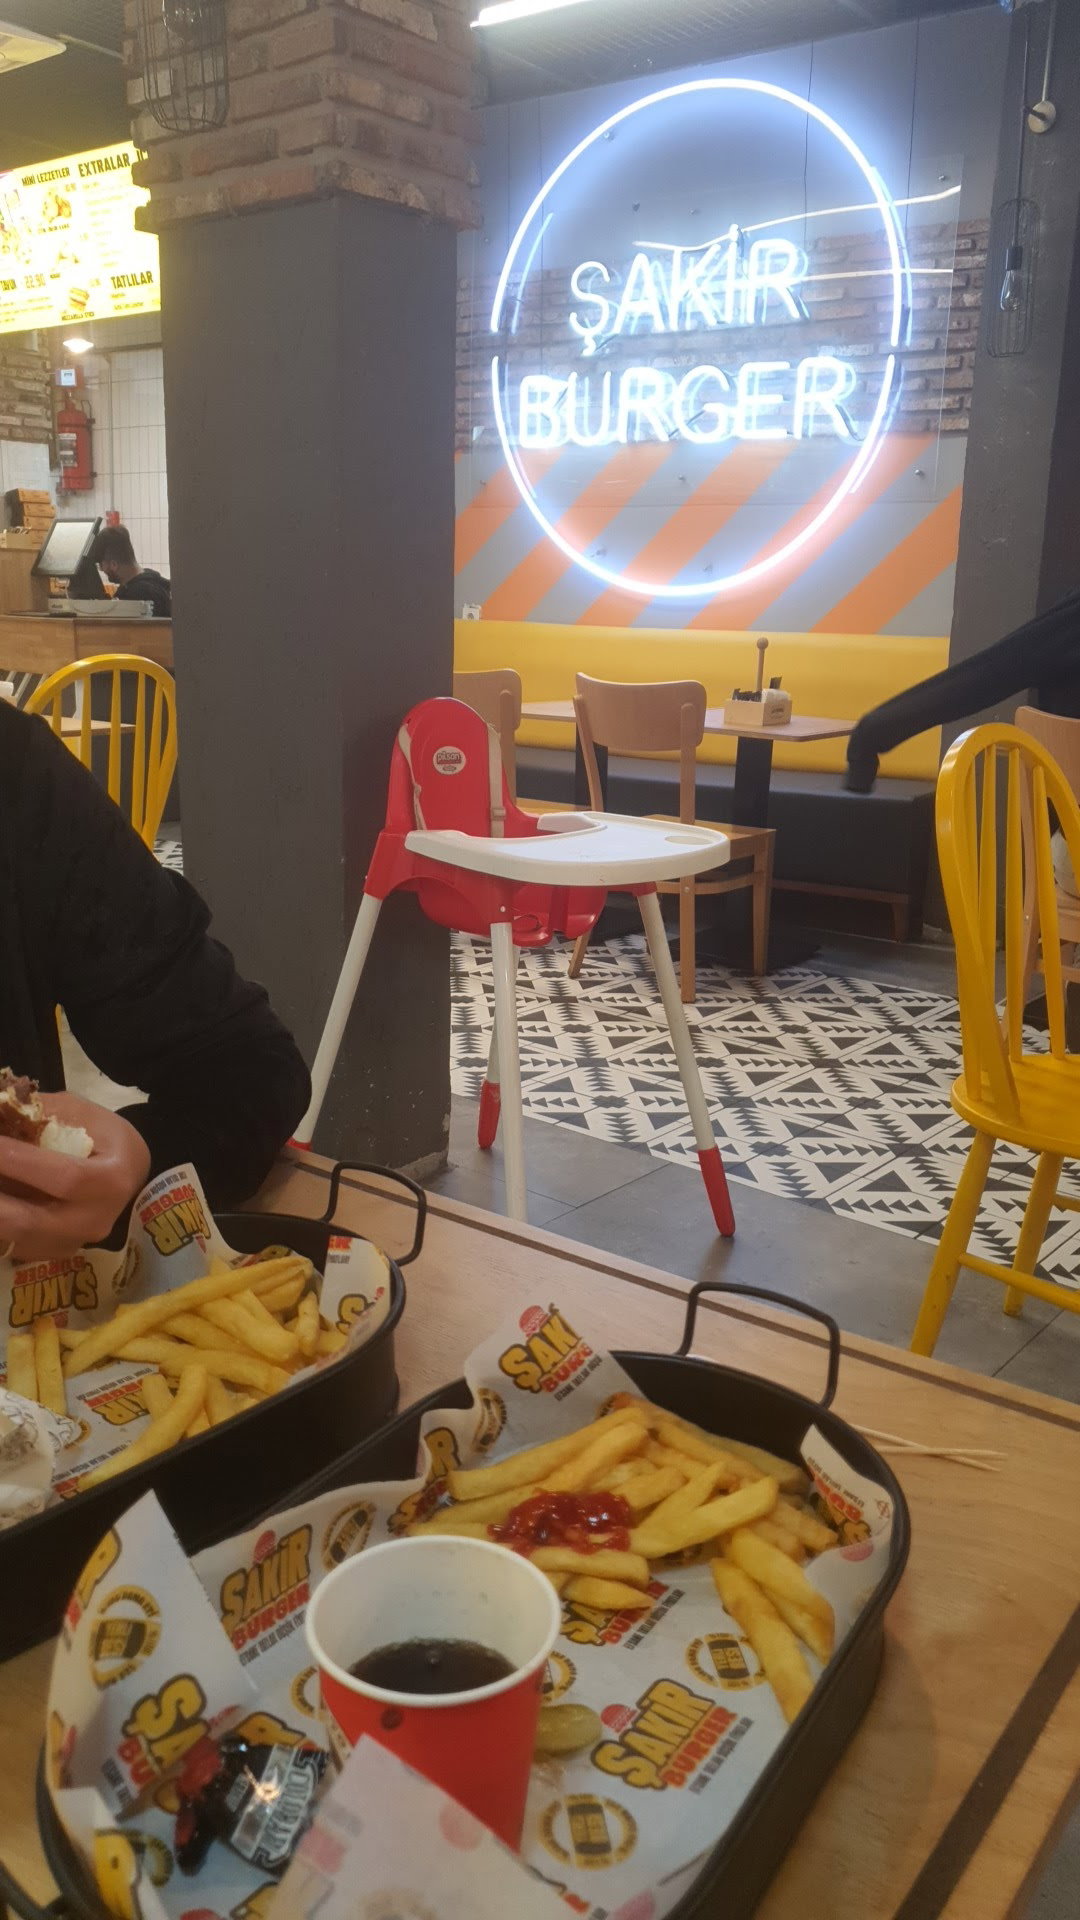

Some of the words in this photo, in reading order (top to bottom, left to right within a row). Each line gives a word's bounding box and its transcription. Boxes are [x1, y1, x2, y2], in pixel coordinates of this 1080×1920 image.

[37, 167, 71, 184] LEZZETLER
[78, 152, 131, 178] EXTRALAR
[110, 270, 154, 290] TATLILAR
[569, 222, 802, 356] ŞAKİR
[518, 355, 856, 449] BURGER
[590, 1678, 716, 1790] ŞAKİR
[661, 1705, 737, 1789] BURGER
